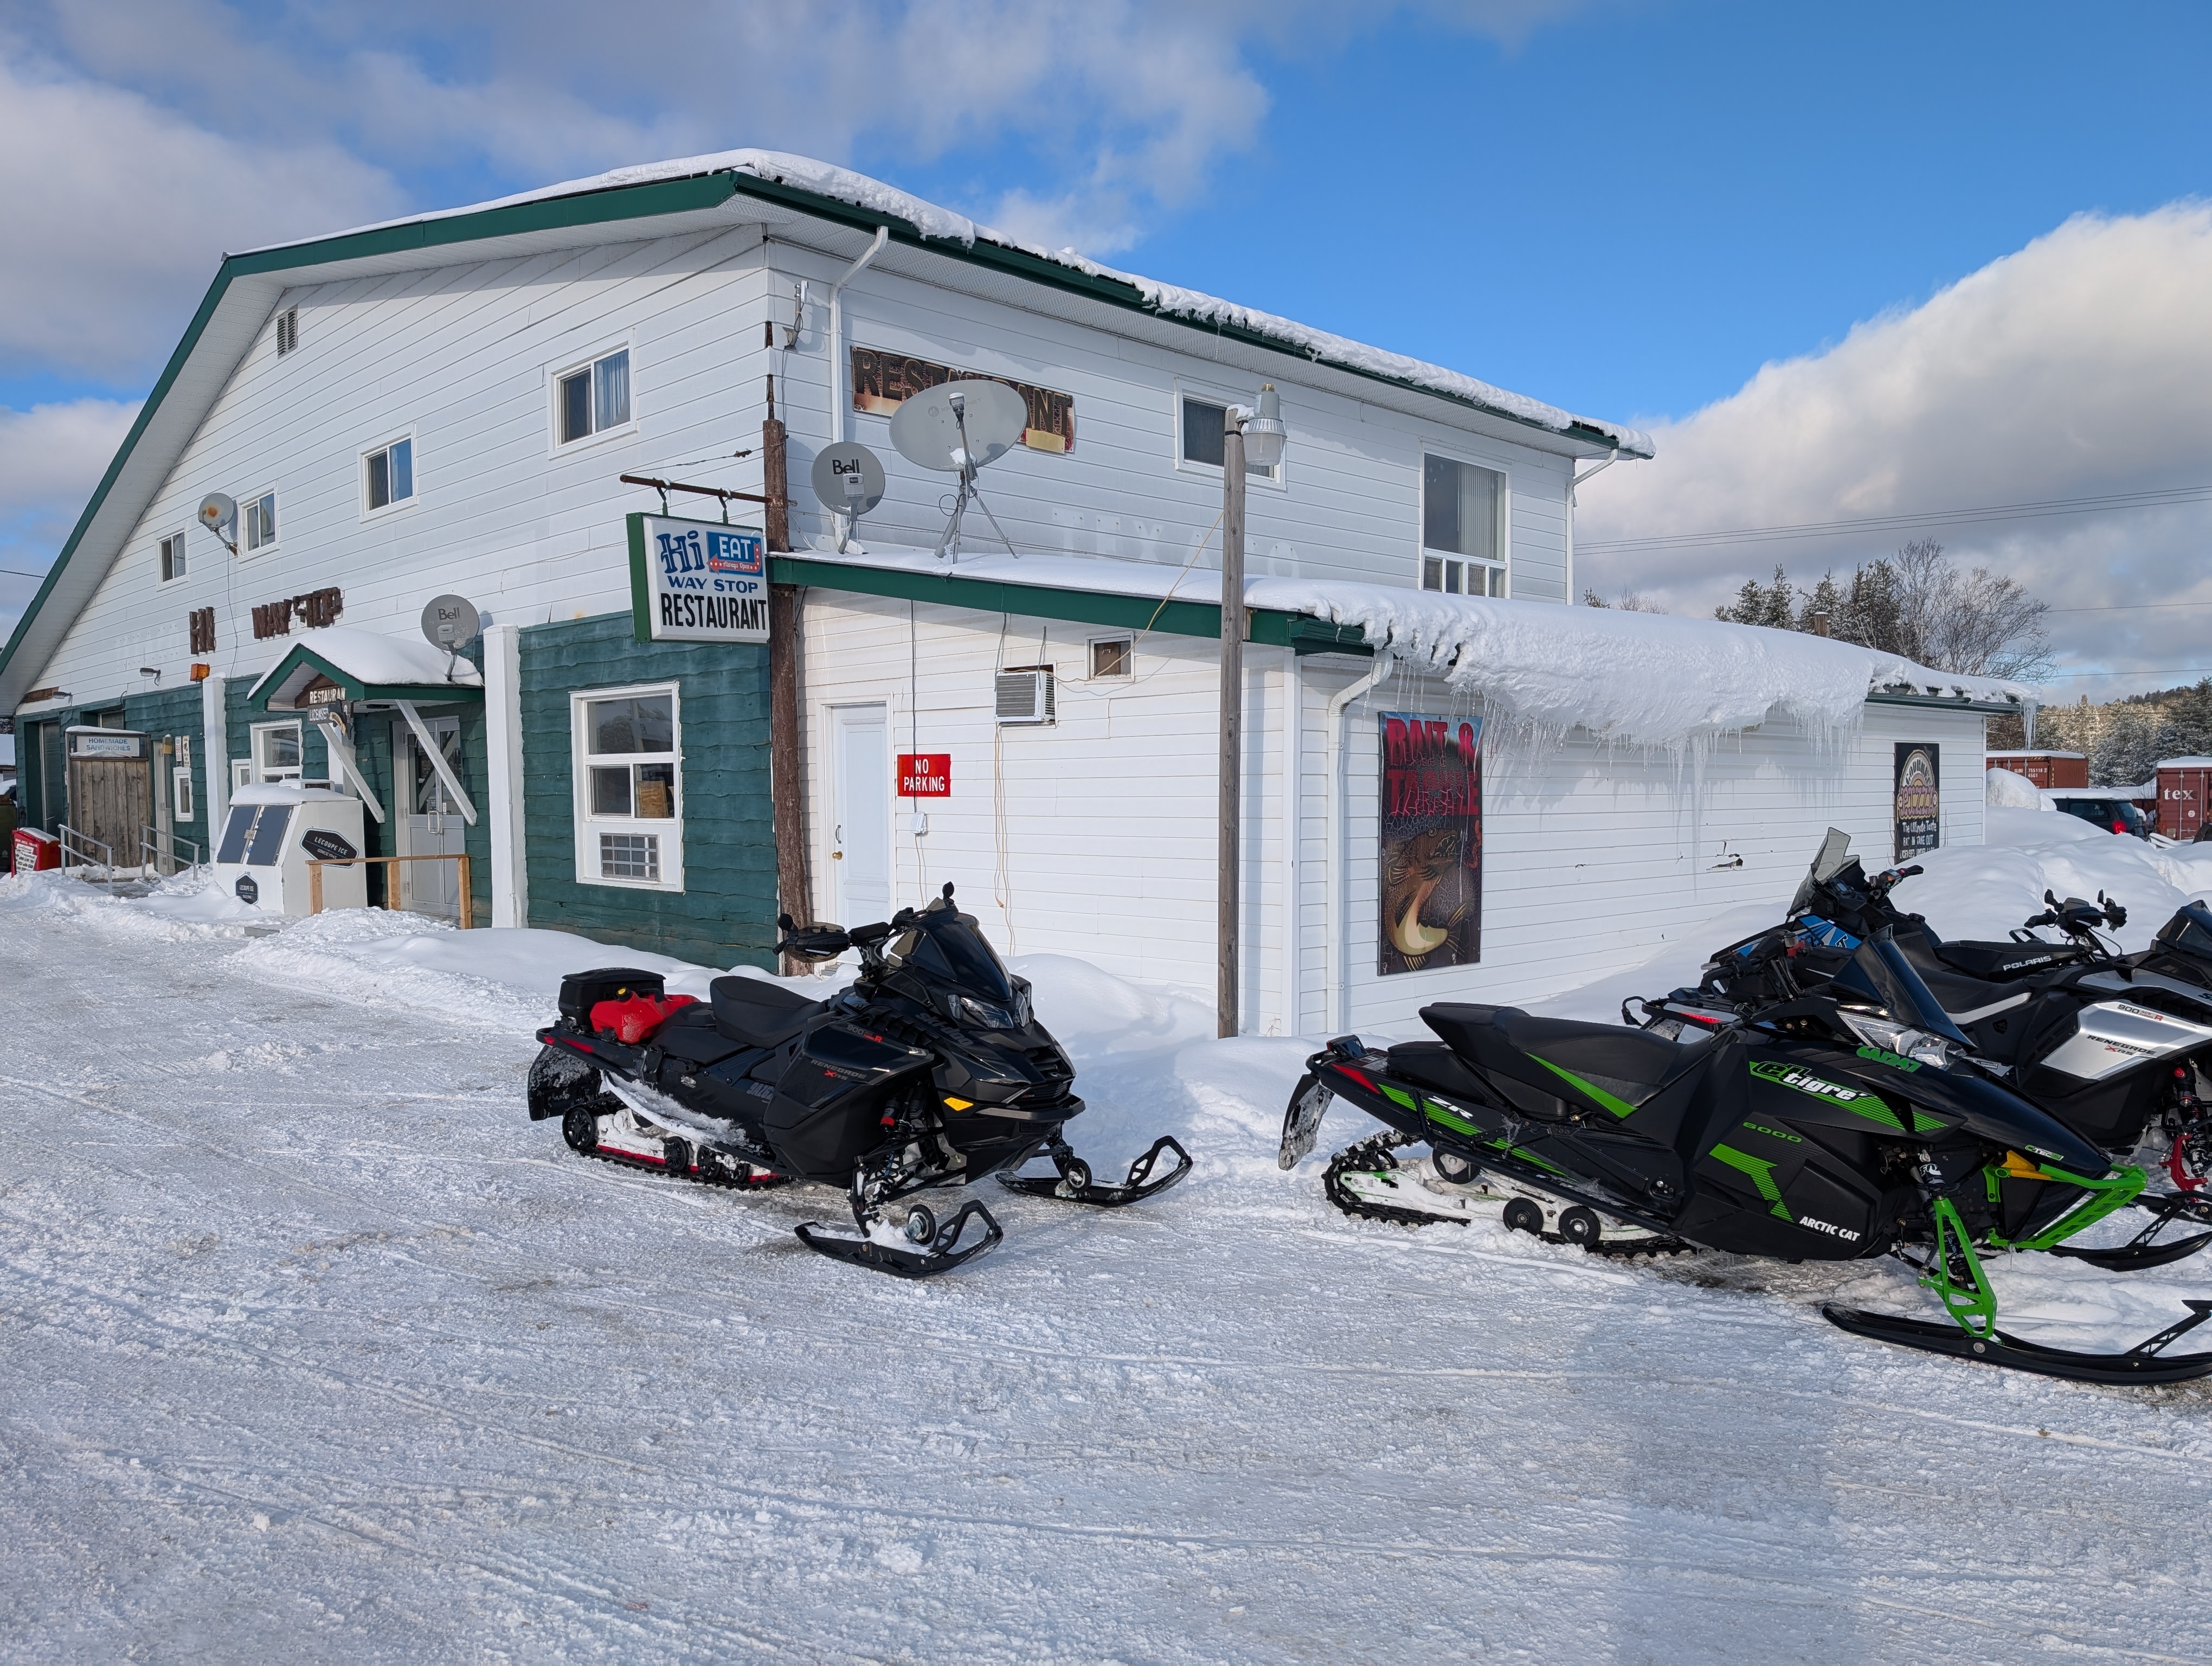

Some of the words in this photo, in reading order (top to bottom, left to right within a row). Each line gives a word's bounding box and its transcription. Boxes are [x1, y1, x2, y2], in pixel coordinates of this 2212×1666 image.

[832, 459, 859, 475] Bell
[657, 530, 705, 573] Hi
[719, 536, 751, 560] EAT
[723, 561, 738, 569] Always
[667, 575, 707, 589] WAY
[713, 578, 758, 593] STOP
[438, 607, 460, 620] Bell
[660, 593, 767, 630] RESTAURANT
[1386, 718, 1449, 766] BAIT
[1457, 722, 1476, 766] &
[915, 759, 929, 774] NO
[904, 776, 945, 791] PARKING
[1900, 786, 1935, 817] PIZZA
[2164, 787, 2194, 800] tex
[1926, 819, 1937, 832] Taste
[314, 837, 338, 851] LECOUPE
[338, 847, 348, 855] ICE
[2003, 956, 2052, 971] POLARIS
[2118, 1004, 2140, 1014] 900
[847, 1025, 864, 1035] 900
[2087, 1034, 2157, 1055] RENEGADE
[811, 1059, 867, 1079] RENEGADE
[1428, 1095, 1474, 1119] ZR
[1742, 1121, 1803, 1143] 6000
[1799, 1216, 1838, 1235] ARCTIC
[1838, 1228, 1861, 1241] CAT
